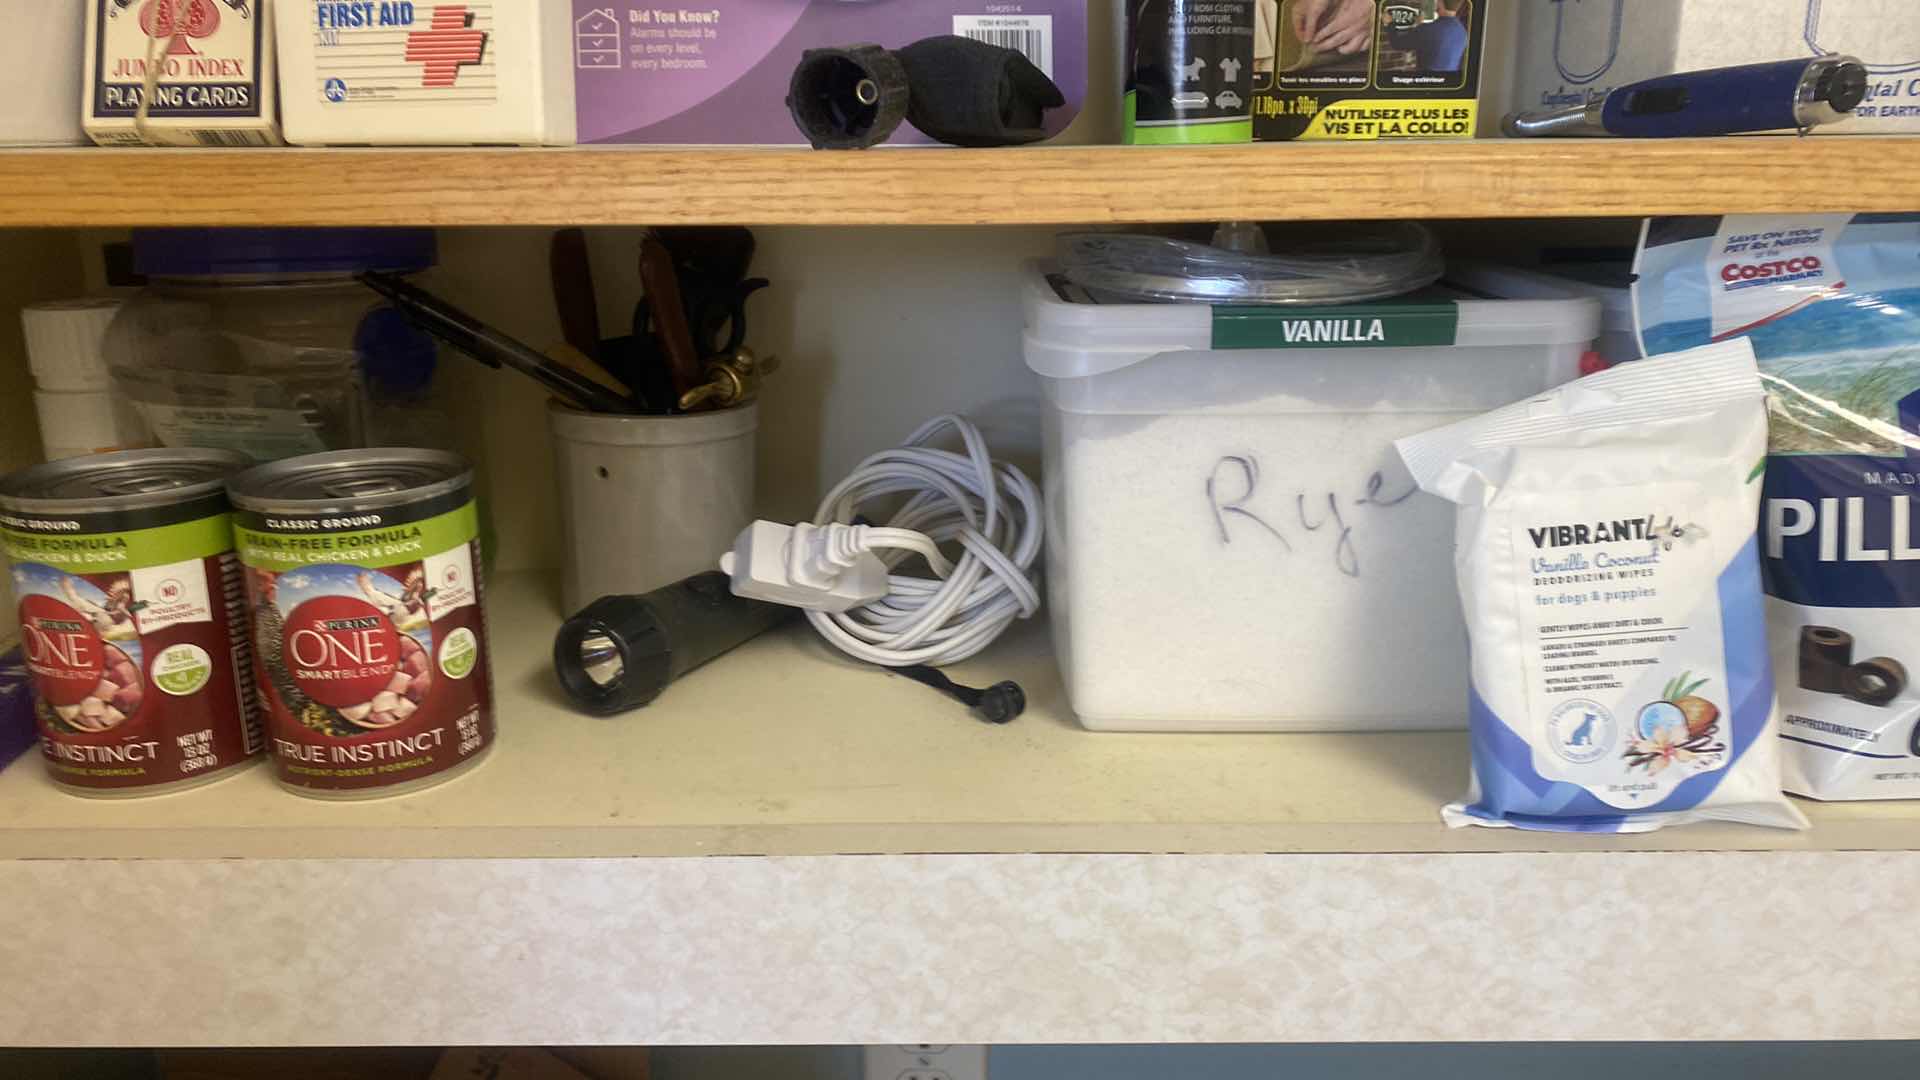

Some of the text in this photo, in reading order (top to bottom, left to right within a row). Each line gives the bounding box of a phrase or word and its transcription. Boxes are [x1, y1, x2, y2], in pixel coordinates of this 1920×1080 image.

[318, 1, 414, 28] FIRST AID
[629, 10, 720, 23] Did You Know?
[1391, 10, 1414, 23] 1024
[631, 28, 717, 39] Alarms should be
[646, 44, 674, 54] every
[188, 58, 245, 77] INDEX
[632, 59, 657, 70] every
[187, 86, 249, 106] CARDS
[1403, 109, 1440, 120] PLUS
[1442, 109, 1469, 120] LES
[1324, 122, 1350, 136] VIS
[1353, 122, 1376, 135] ET
[1379, 122, 1403, 135] LA
[1762, 230, 1785, 240] ON
[1772, 235, 1823, 249] NEEDS
[1721, 255, 1823, 284] COSTCO
[1281, 317, 1385, 343] VANILLA
[265, 514, 383, 530] CLASSIC GROUND
[39, 537, 128, 551] FORMULA
[338, 526, 422, 548] FORMULA
[72, 550, 83, 562] &
[84, 550, 128, 562] DUCK
[273, 549, 304, 563] REAL
[306, 546, 370, 564] CHICKEN
[373, 547, 382, 557] &
[383, 540, 423, 556] DUCK
[1530, 546, 1660, 574] Vanilla Coconut
[1618, 567, 1655, 580] WIPES
[1536, 587, 1657, 606] for dogs & puppies
[289, 629, 389, 668] ONE
[54, 740, 160, 764] INSTINCT
[273, 738, 330, 764] TRUE
[330, 727, 446, 764] INSTINCT
